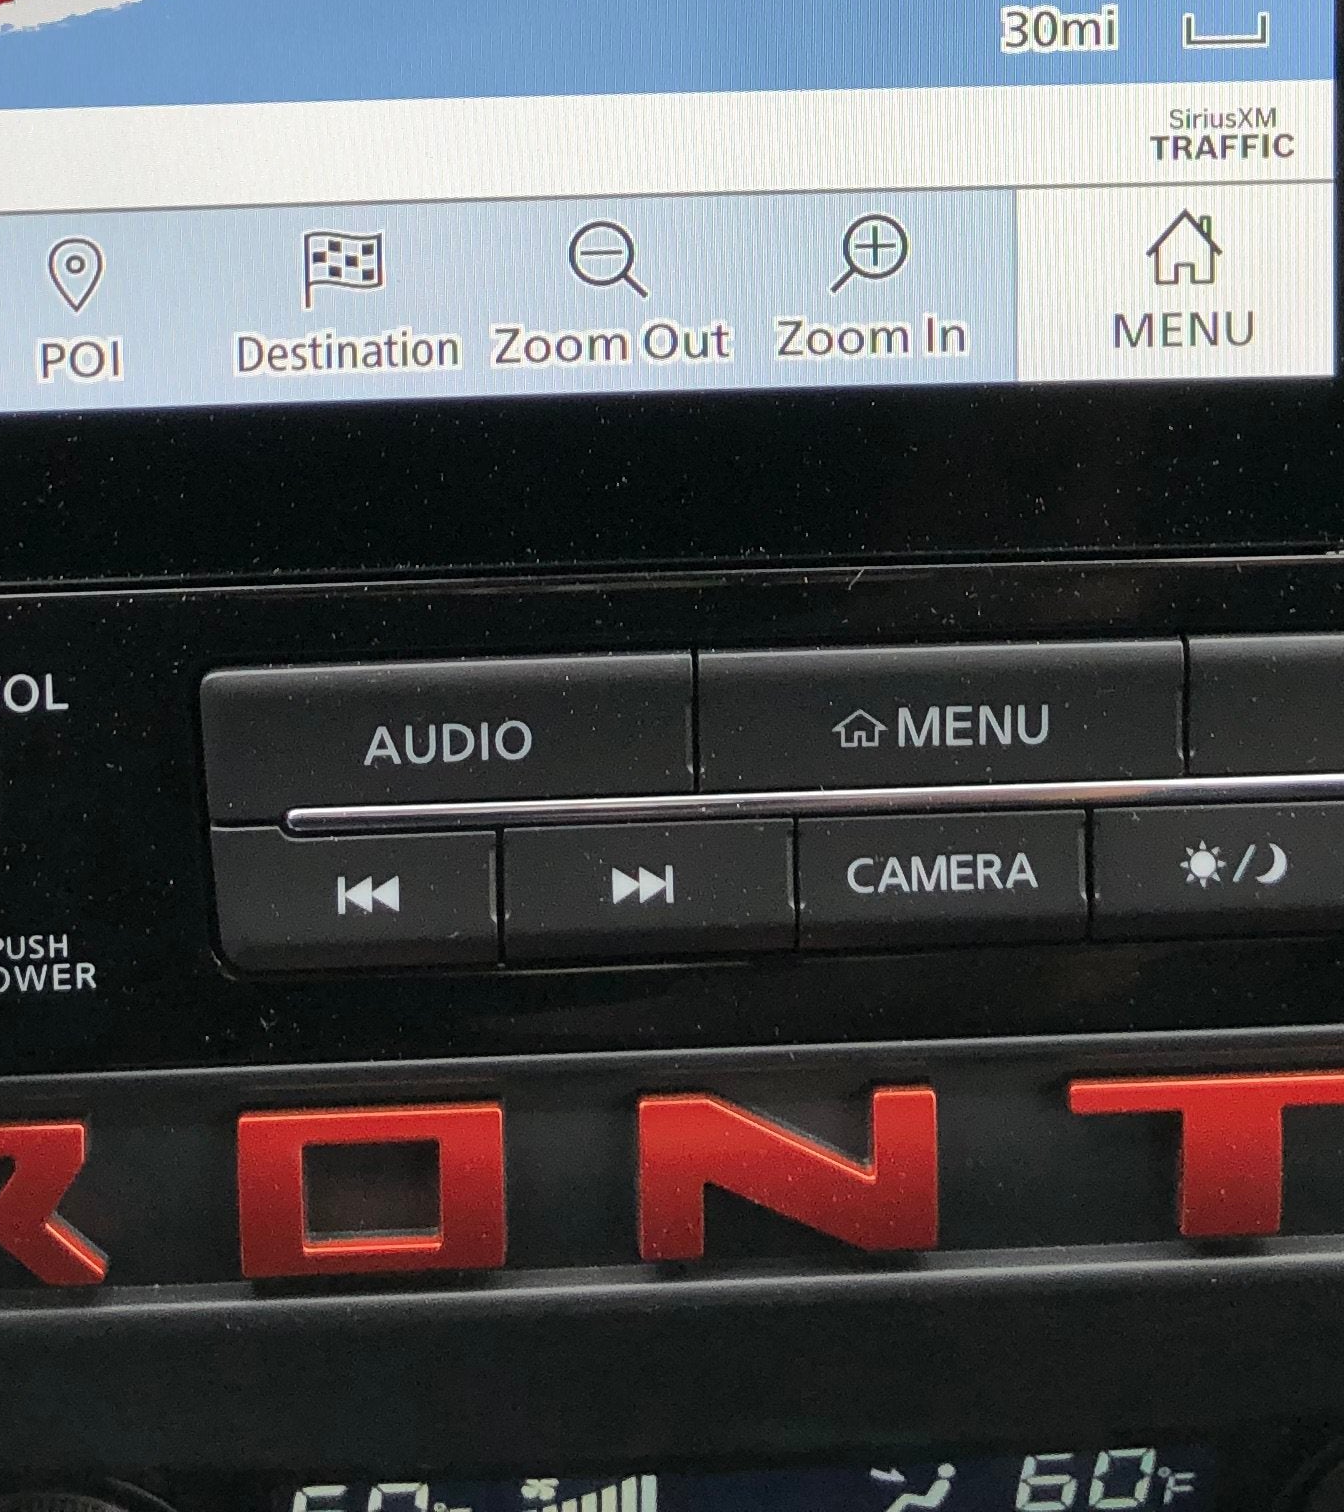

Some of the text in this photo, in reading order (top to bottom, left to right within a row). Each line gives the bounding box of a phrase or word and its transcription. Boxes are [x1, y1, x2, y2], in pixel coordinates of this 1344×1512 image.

[1003, 7, 1117, 50] 30mi
[1169, 107, 1278, 130] SiriusXM
[1150, 133, 1295, 161] TRAFFIC
[237, 330, 458, 373] Destination
[494, 321, 731, 364] Zoom Out
[777, 316, 967, 358] Zoom In
[1113, 311, 1256, 349] MENU
[41, 338, 121, 379] POI
[363, 720, 534, 766] AUDIO
[896, 704, 1050, 747] MENU
[847, 851, 1039, 894] CAMERA
